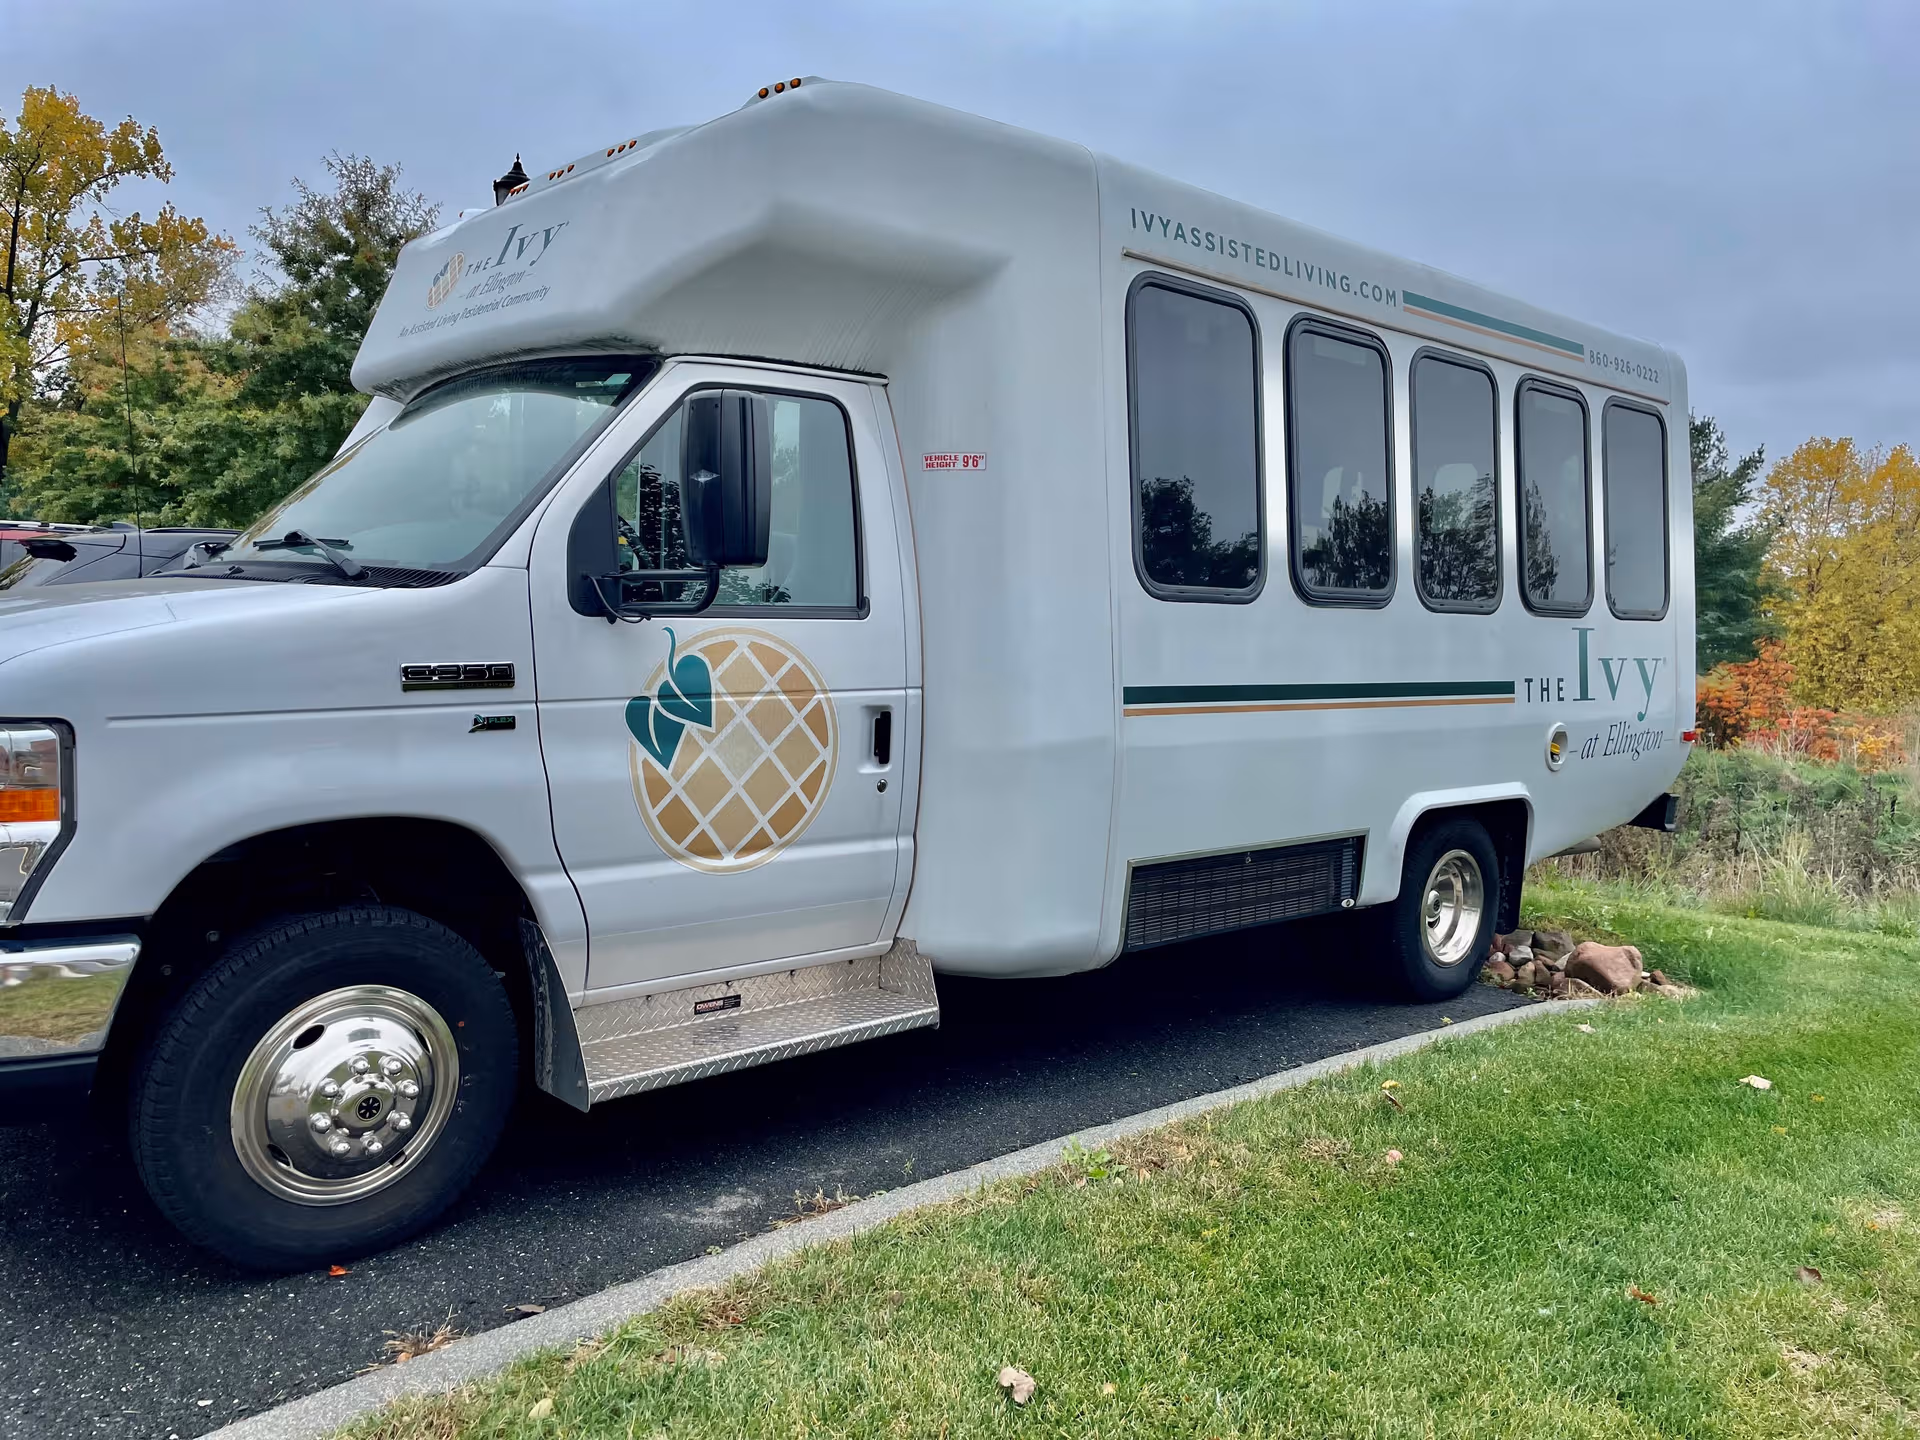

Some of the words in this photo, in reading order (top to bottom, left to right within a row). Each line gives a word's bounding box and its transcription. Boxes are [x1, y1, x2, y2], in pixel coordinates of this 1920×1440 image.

[465, 257, 492, 277] THE
[491, 223, 566, 267] Ivy
[1131, 207, 1397, 308] IVYASSISTEDLIVING.COM
[501, 285, 551, 308] Community
[1589, 349, 1659, 384] 860-926-0222
[924, 454, 959, 462] VEHICLE
[925, 461, 957, 469] HEIGHT
[1524, 678, 1565, 703] THE
[1572, 627, 1662, 722] Ivy
[488, 716, 514, 724] FLEX
[1580, 733, 1599, 760] at
[1602, 721, 1664, 761] Ellington
